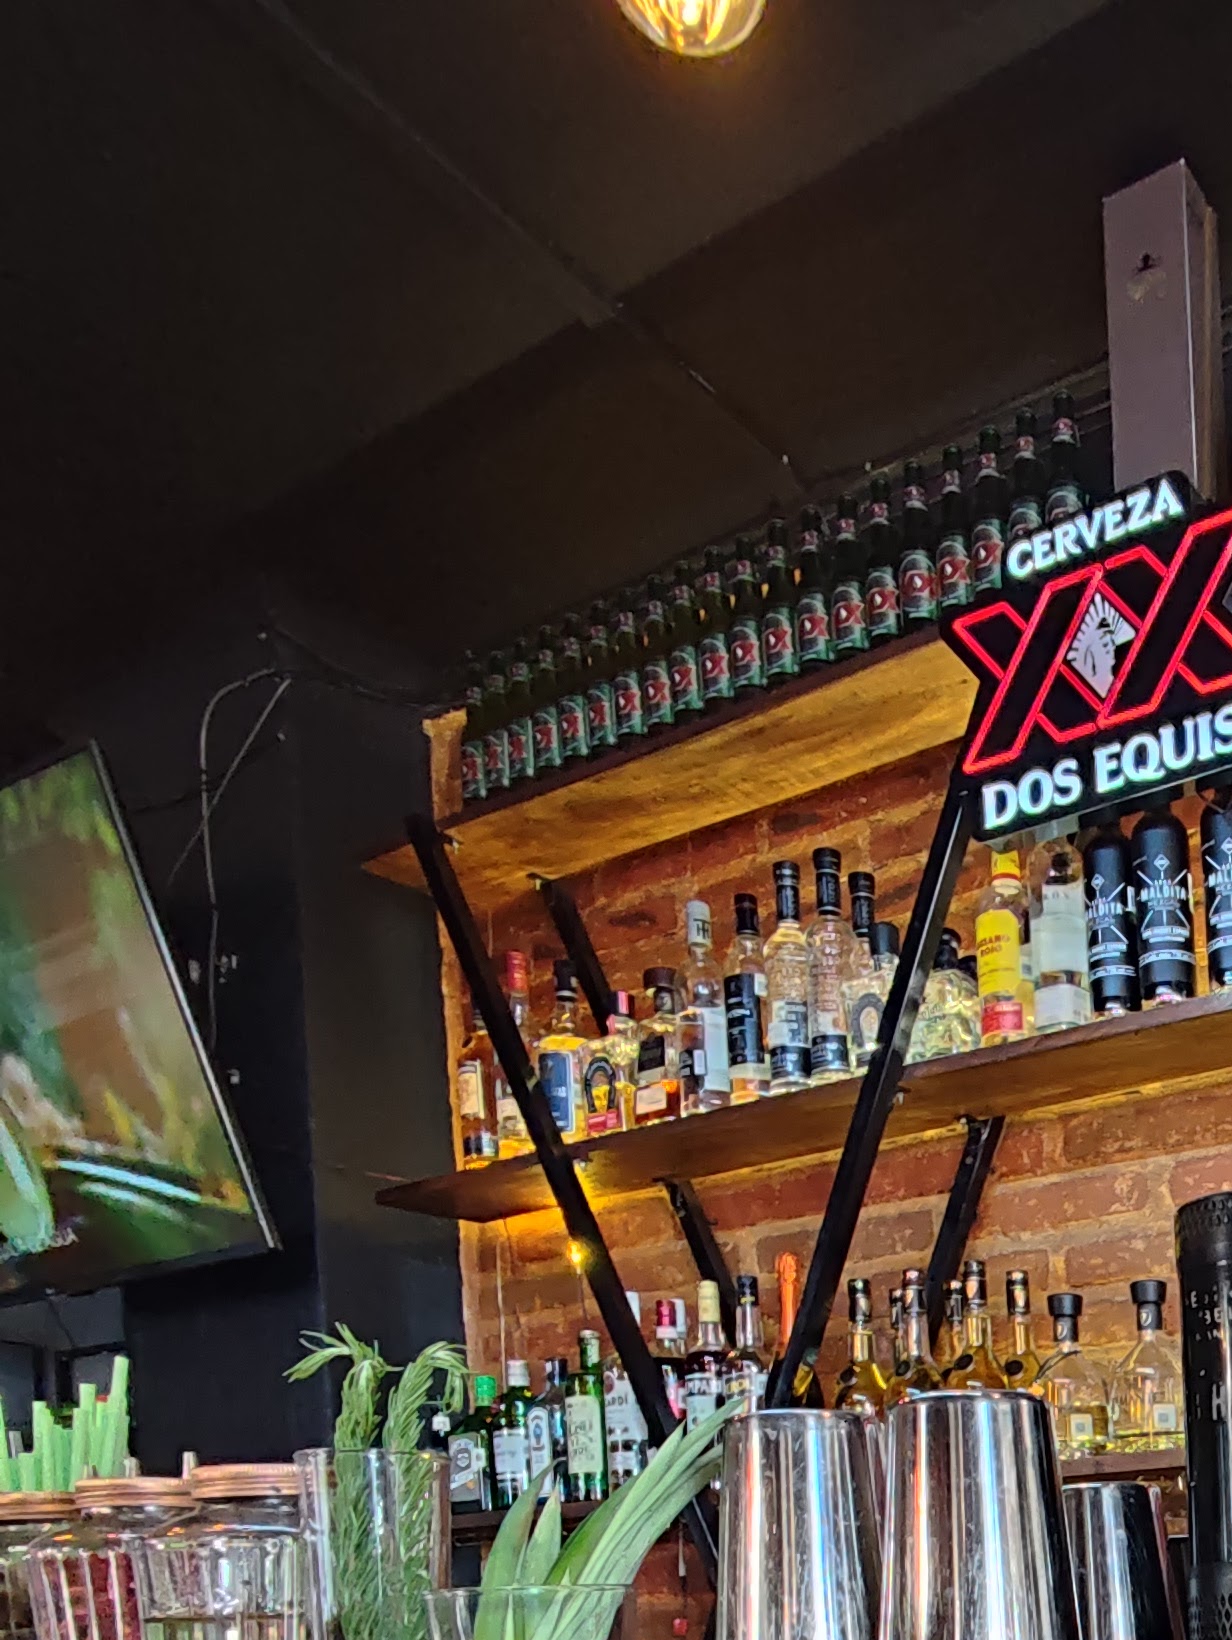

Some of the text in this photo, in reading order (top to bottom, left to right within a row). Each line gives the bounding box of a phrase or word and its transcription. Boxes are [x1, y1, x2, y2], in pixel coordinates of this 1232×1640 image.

[1007, 478, 1184, 578] CERVEZA
[981, 758, 1082, 831] DOS
[1140, 884, 1187, 902] MALDITA
